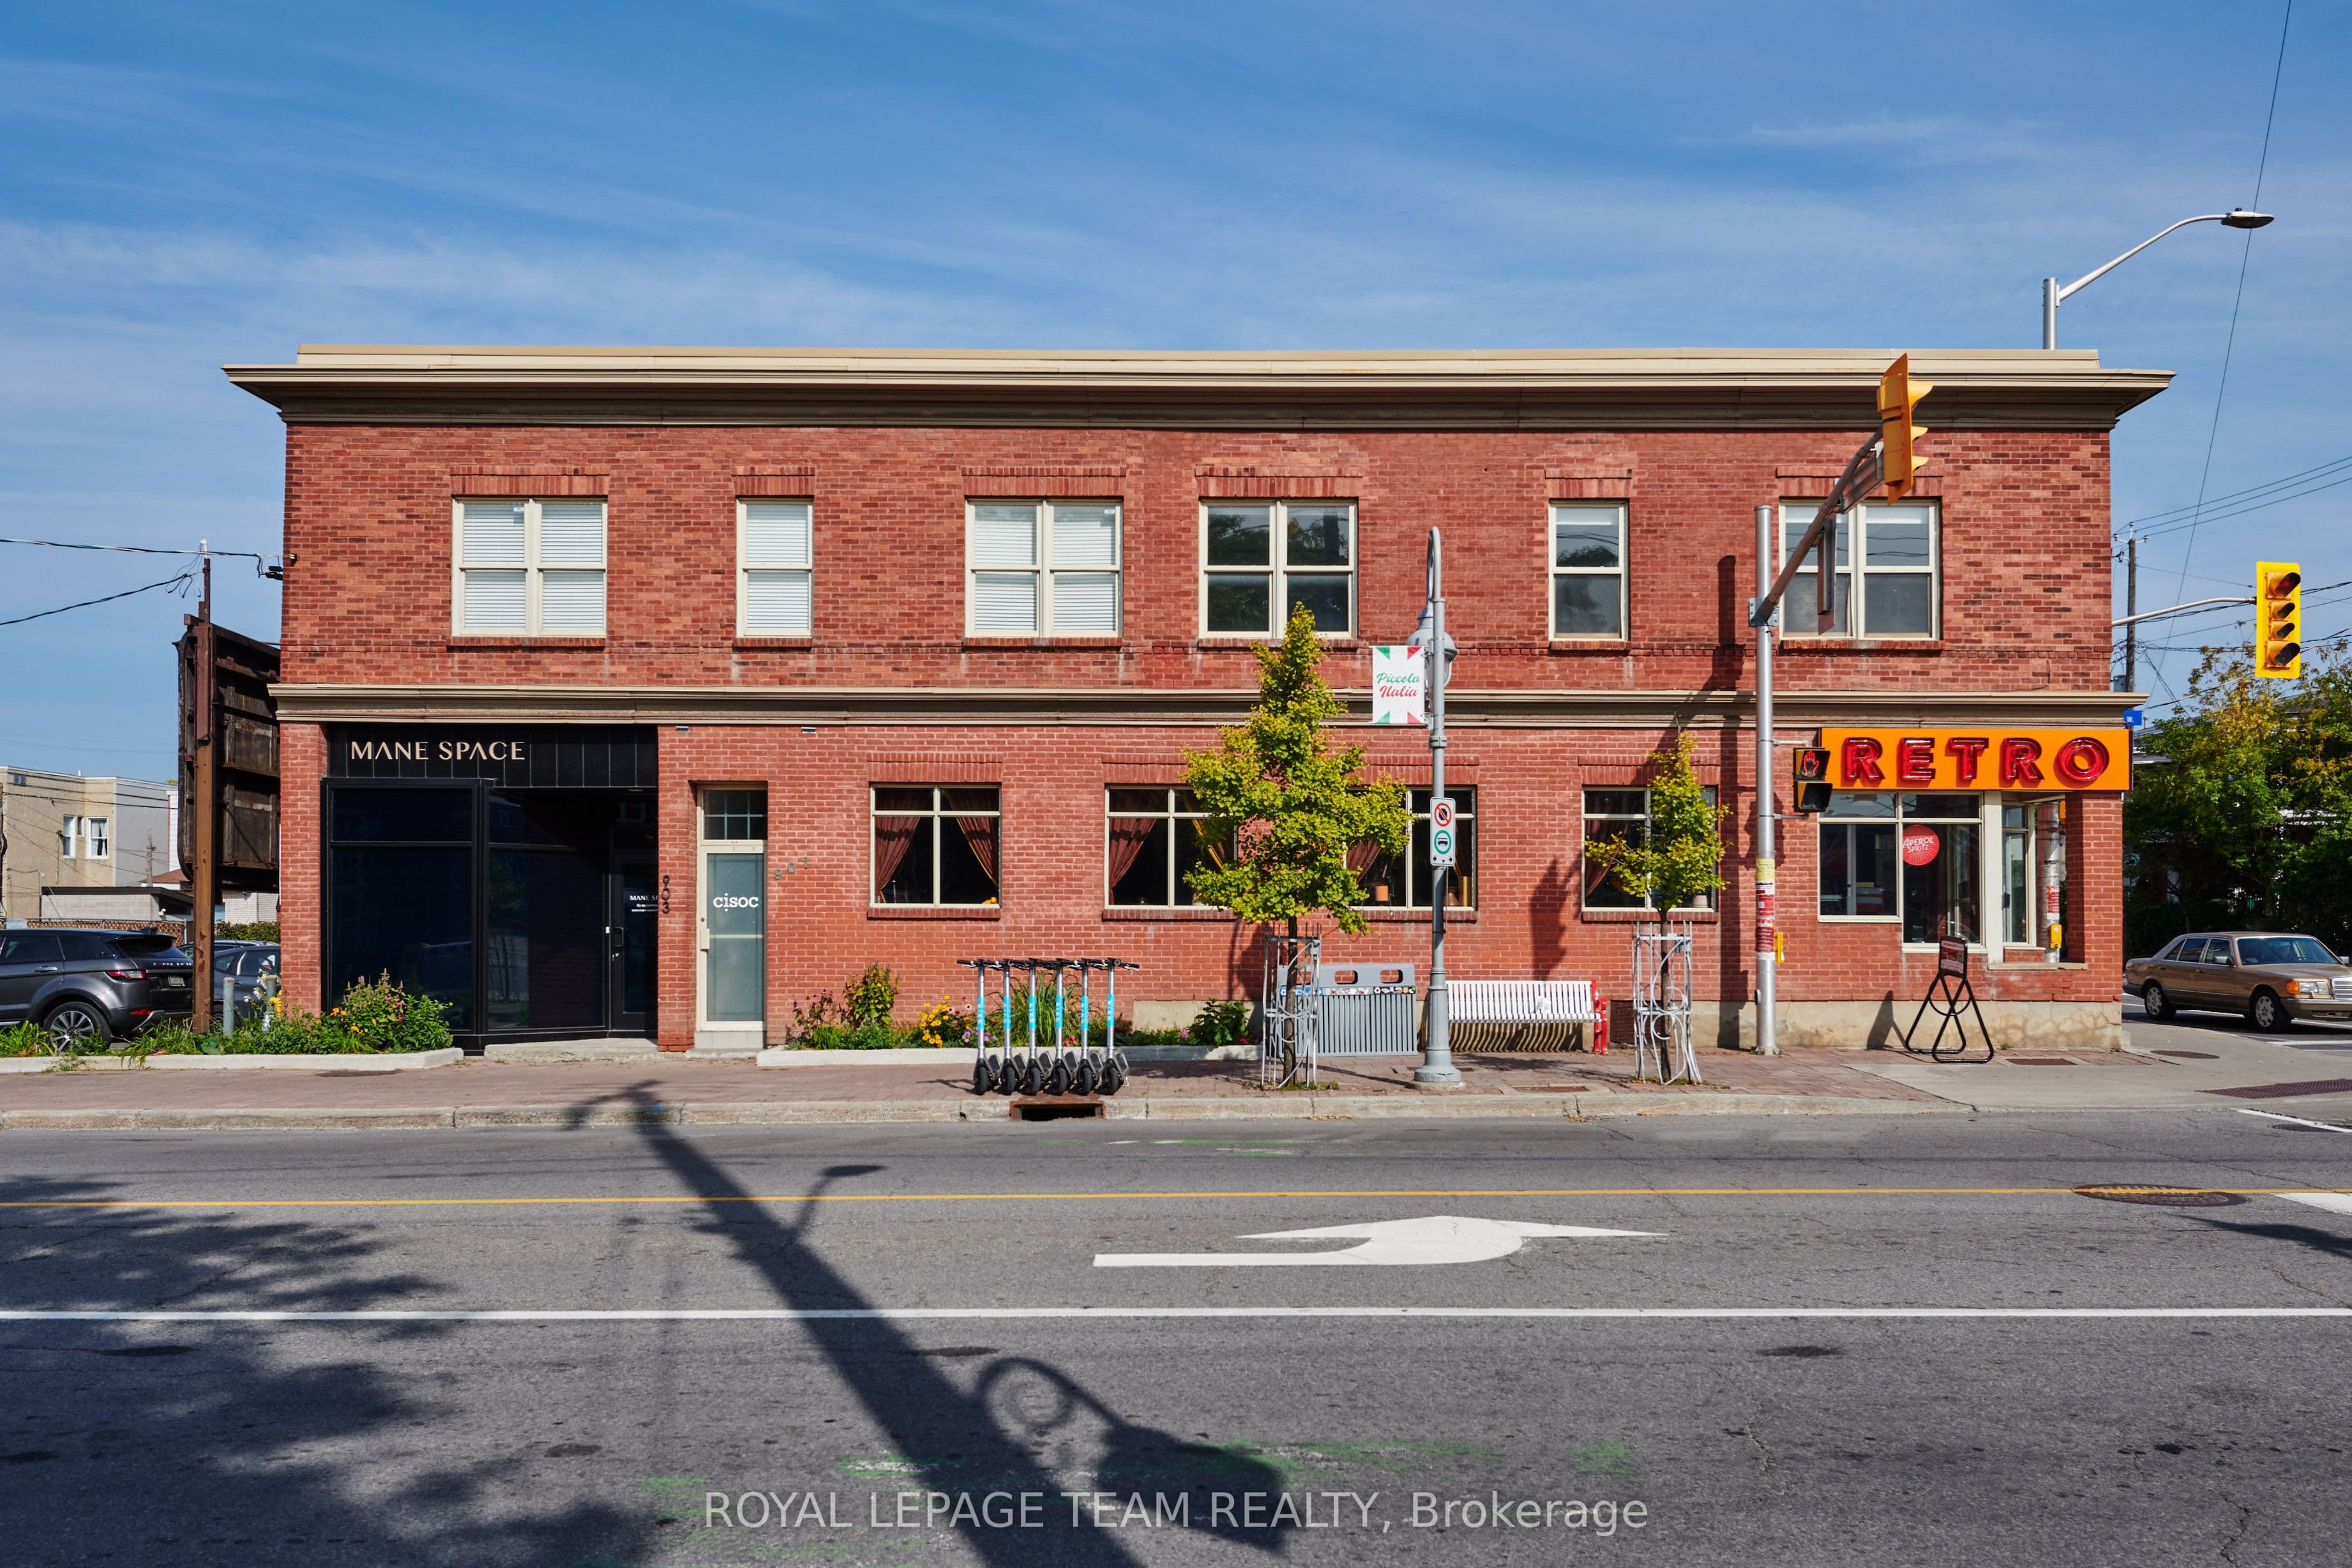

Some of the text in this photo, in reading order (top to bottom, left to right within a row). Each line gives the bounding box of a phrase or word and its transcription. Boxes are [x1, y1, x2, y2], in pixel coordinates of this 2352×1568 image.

[1376, 672, 1420, 684] Piccola
[1380, 685, 1417, 698] Italia
[351, 741, 525, 760] MANE SPACE
[1843, 736, 2110, 781] RETRO
[1903, 836, 1934, 848] APEROL
[774, 857, 808, 880] 901
[661, 874, 670, 914] 903
